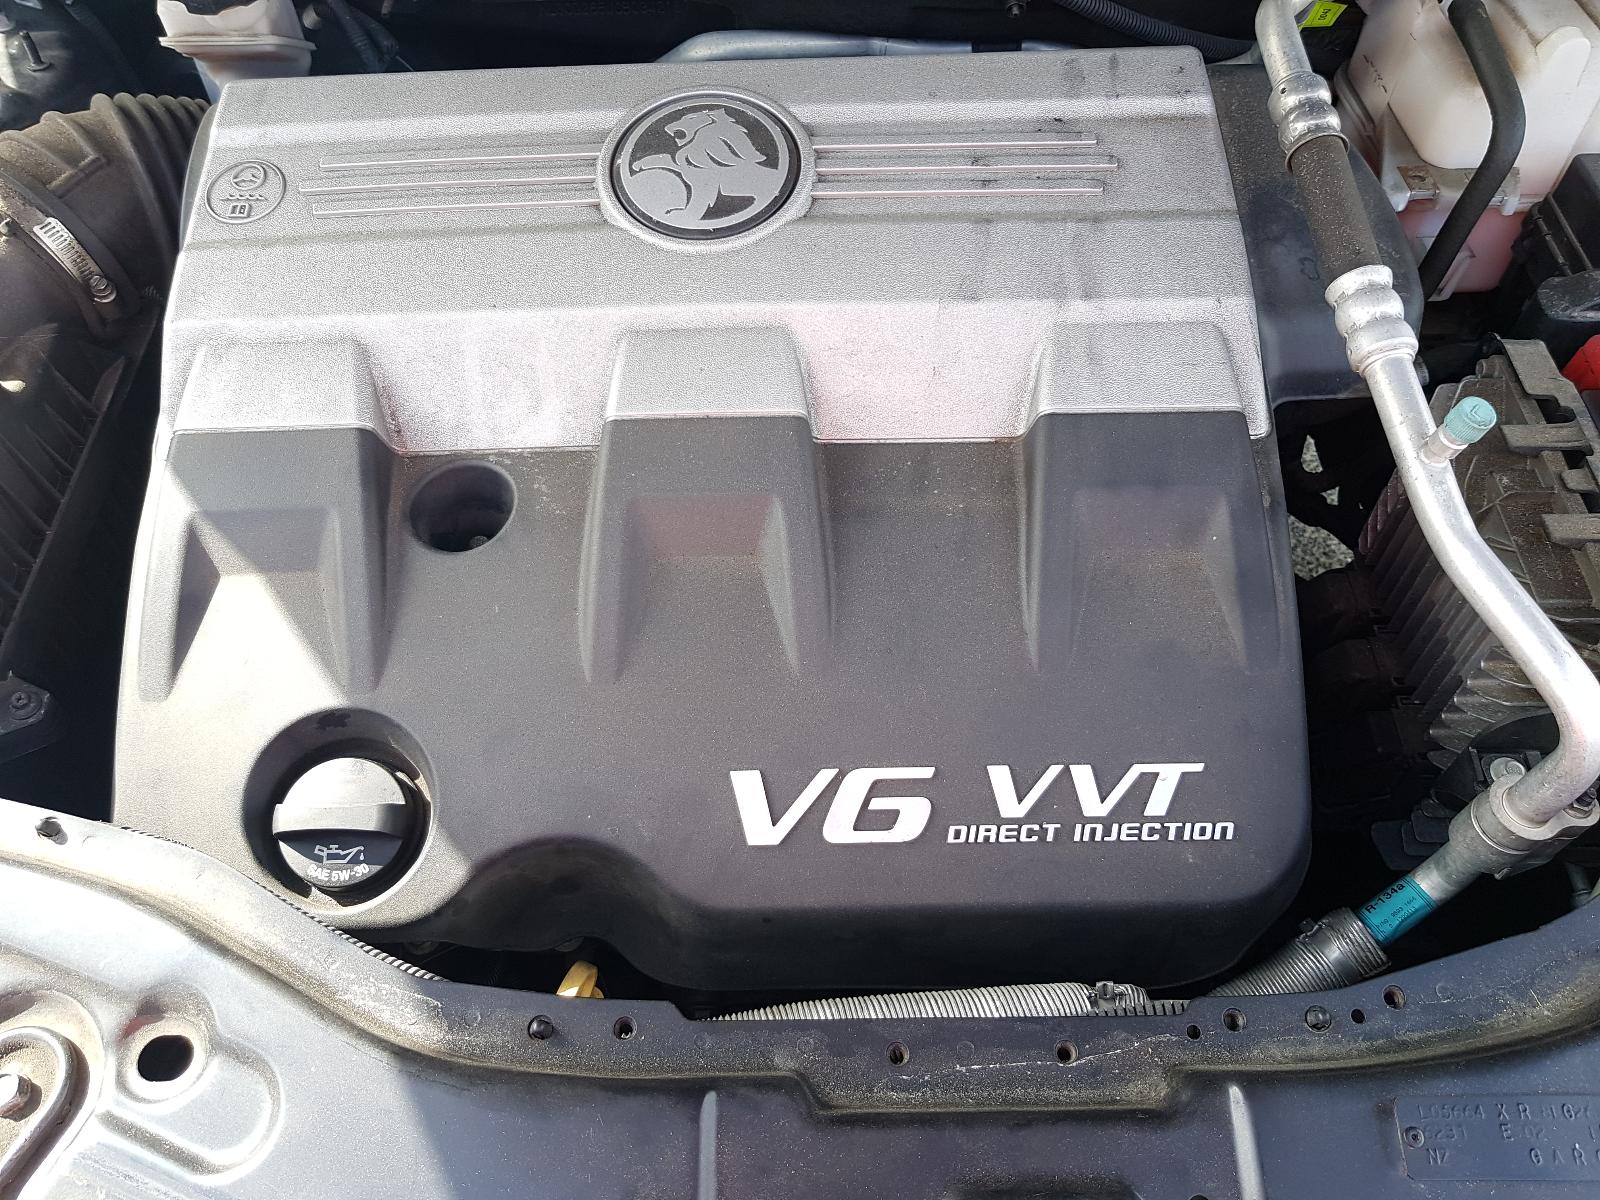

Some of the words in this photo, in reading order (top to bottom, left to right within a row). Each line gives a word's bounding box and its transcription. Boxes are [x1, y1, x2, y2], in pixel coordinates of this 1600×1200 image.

[729, 766, 936, 846] V6
[986, 762, 1206, 819] VVT
[946, 822, 1062, 844] DIRECT
[1073, 821, 1236, 843] INJECTION
[307, 863, 330, 880] SAE
[331, 862, 370, 881] 5W-30
[1364, 882, 1406, 914] R-134a
